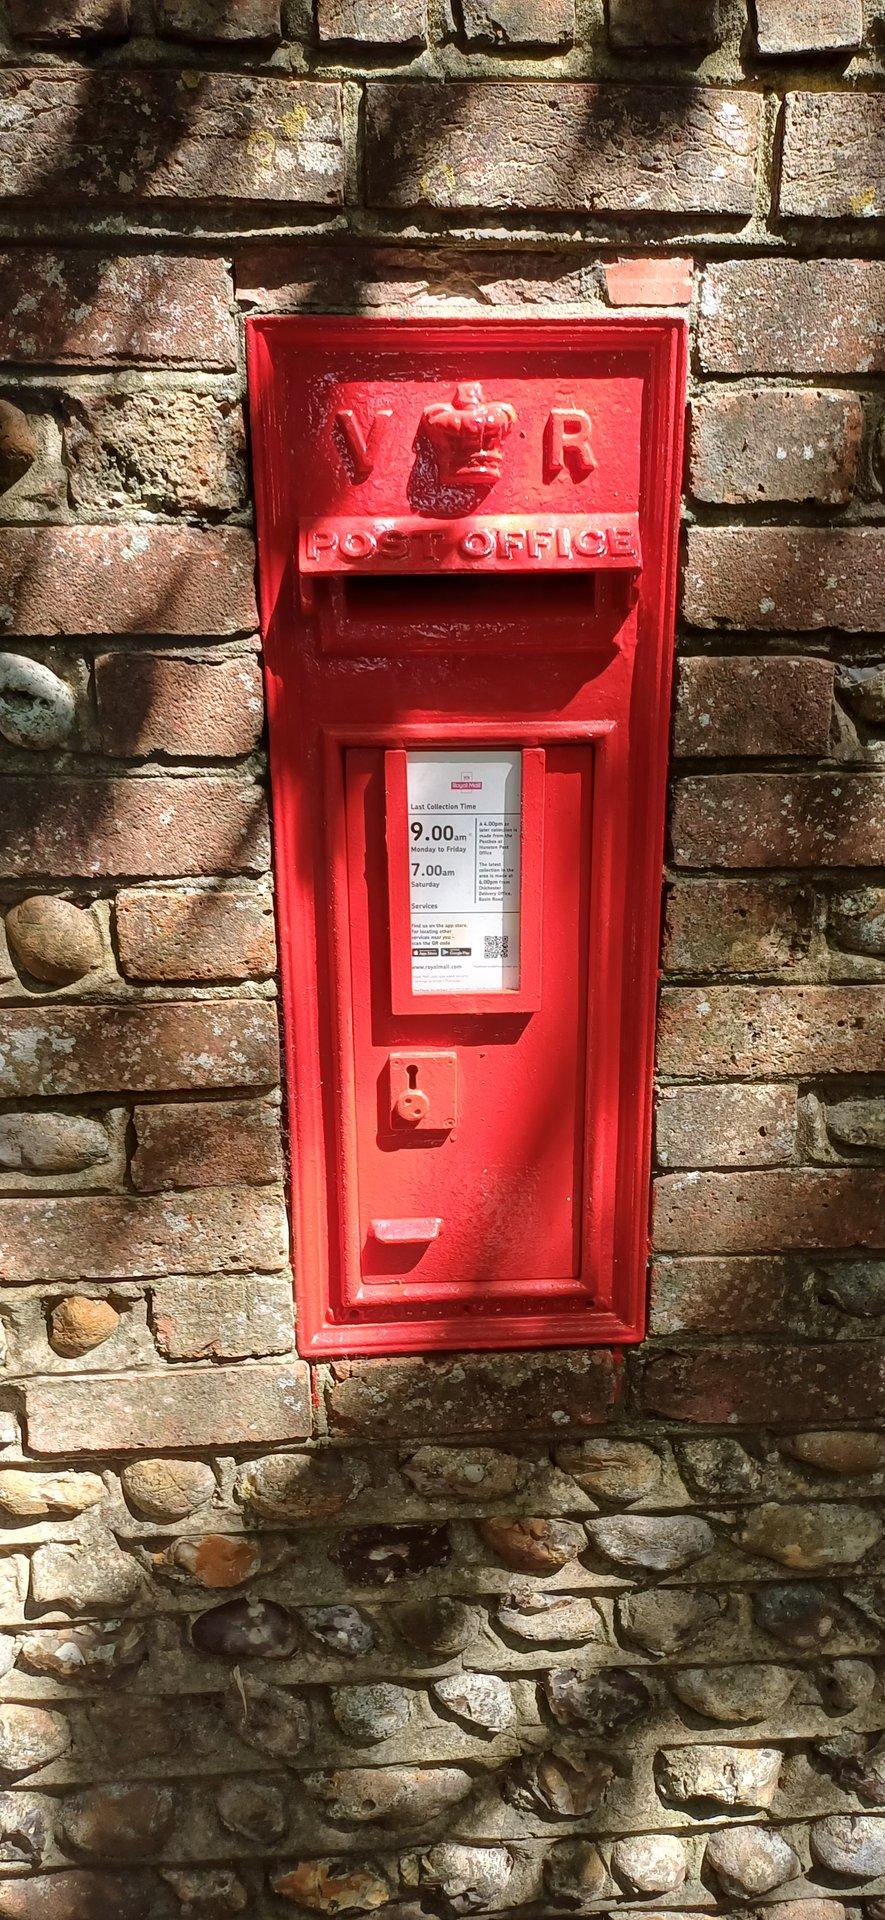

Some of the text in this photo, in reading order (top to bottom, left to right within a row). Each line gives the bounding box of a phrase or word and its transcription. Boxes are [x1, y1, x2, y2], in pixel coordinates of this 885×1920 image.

[334, 408, 597, 484] V R
[306, 526, 637, 562] POST OFFICE
[452, 782, 469, 790] Royal
[410, 822, 467, 841] 9.00am
[411, 863, 455, 877] 7.00am
